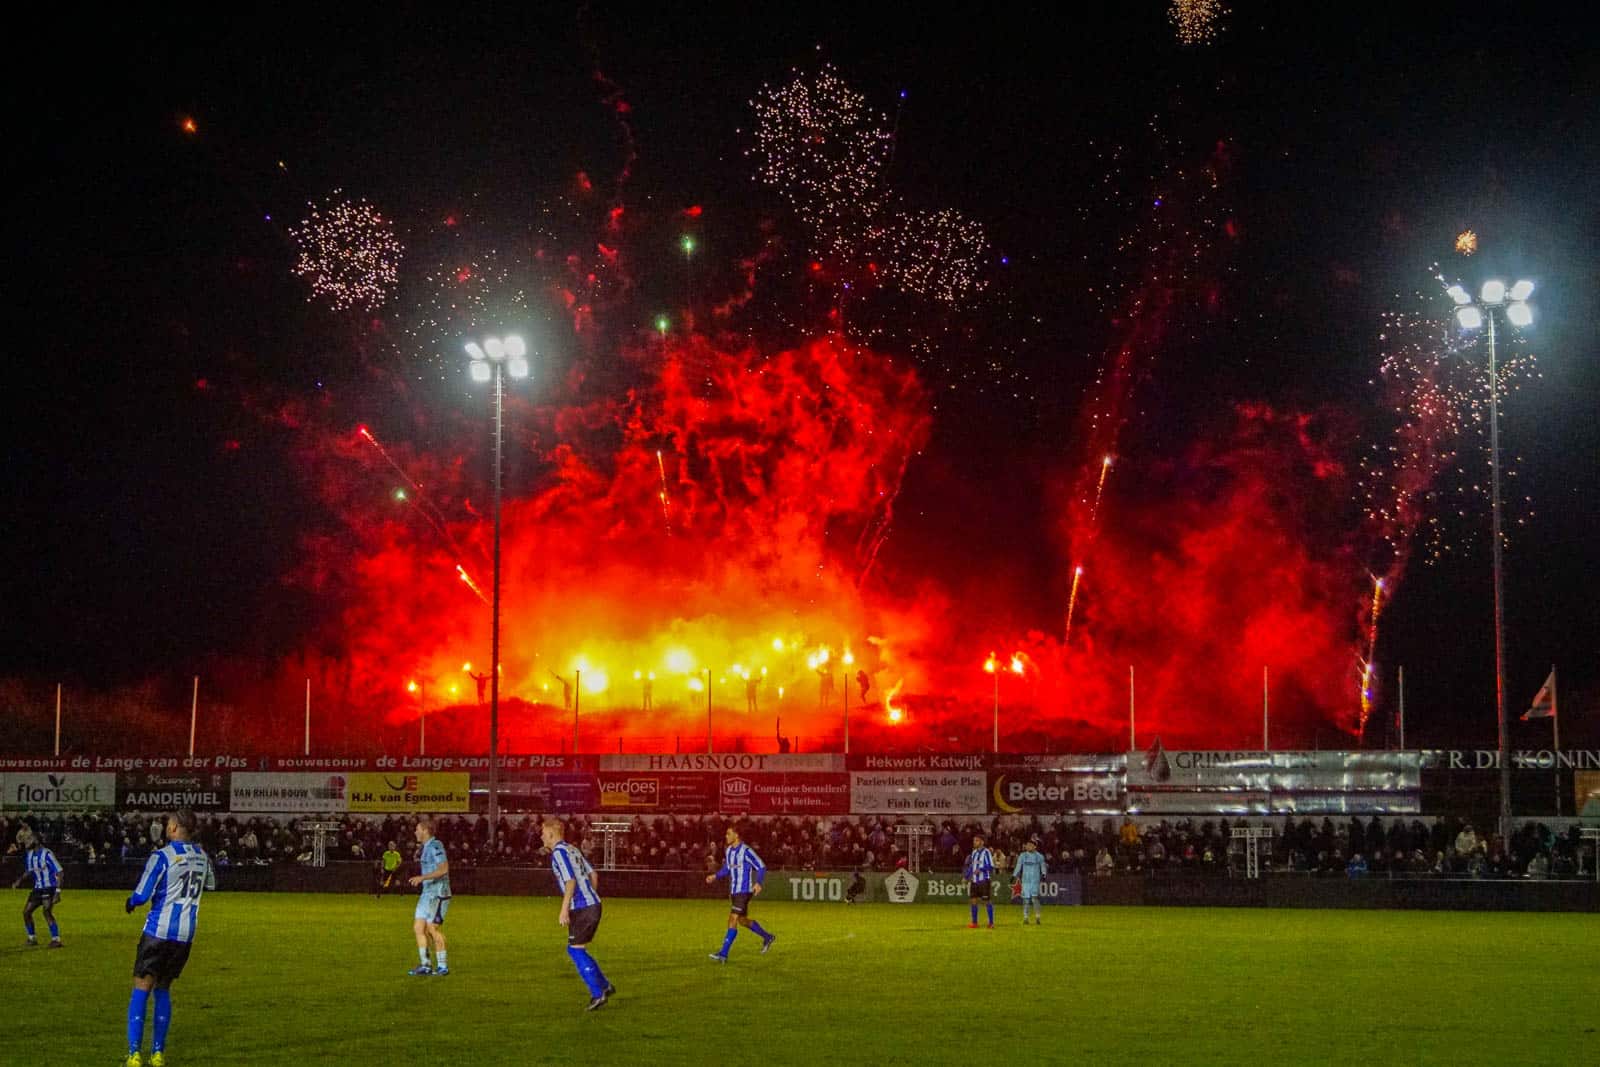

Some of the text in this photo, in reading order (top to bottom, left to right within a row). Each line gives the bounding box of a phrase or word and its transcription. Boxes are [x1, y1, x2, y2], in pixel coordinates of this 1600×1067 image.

[71, 755, 90, 768] de
[183, 755, 210, 768] der
[215, 755, 248, 768] Plas
[278, 759, 367, 767] BOUWBEDRIJF
[376, 755, 398, 768] de
[529, 755, 565, 768] Plas
[650, 755, 768, 770] HAASNOOT
[866, 755, 982, 770] Hekwerk Katwijk
[1448, 750, 1471, 769] R.
[597, 777, 656, 793] verdoes
[856, 776, 905, 786] Parlevliet
[919, 776, 938, 786] Van
[940, 776, 958, 786] der
[960, 776, 982, 786] Plas
[17, 783, 100, 802] florisoft
[125, 791, 221, 805] AANDEWIEL
[234, 788, 251, 798] VAN
[281, 788, 308, 798] BOUW
[351, 792, 376, 802] H.H.
[380, 794, 402, 802] van
[405, 792, 454, 804] Egmond
[1008, 781, 1069, 801] Beter
[1073, 780, 1118, 801] Bed
[887, 798, 952, 809] Fish for life
[178, 870, 204, 899] 15
[789, 878, 842, 900] TOTO
